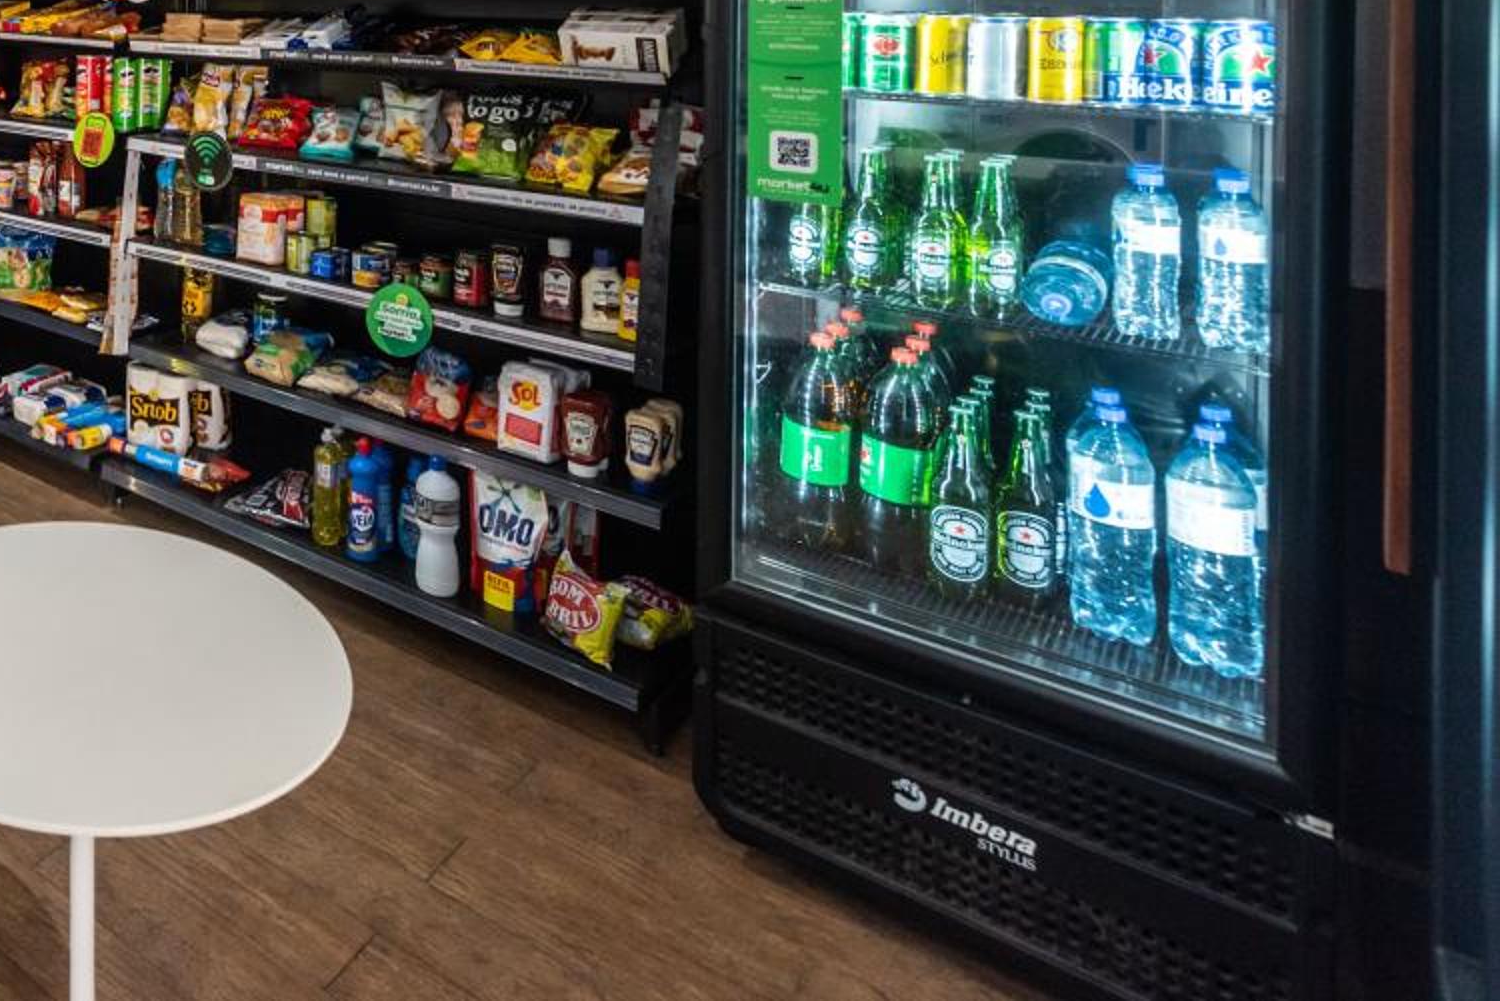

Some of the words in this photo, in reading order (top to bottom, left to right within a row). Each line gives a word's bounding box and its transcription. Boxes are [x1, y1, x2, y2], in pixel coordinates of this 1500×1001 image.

[488, 106, 519, 124] go
[756, 177, 830, 194] market4u
[131, 396, 178, 422] Snob
[479, 504, 536, 547] OMO
[549, 599, 595, 630] BRIL
[930, 797, 1038, 857] Imbera
